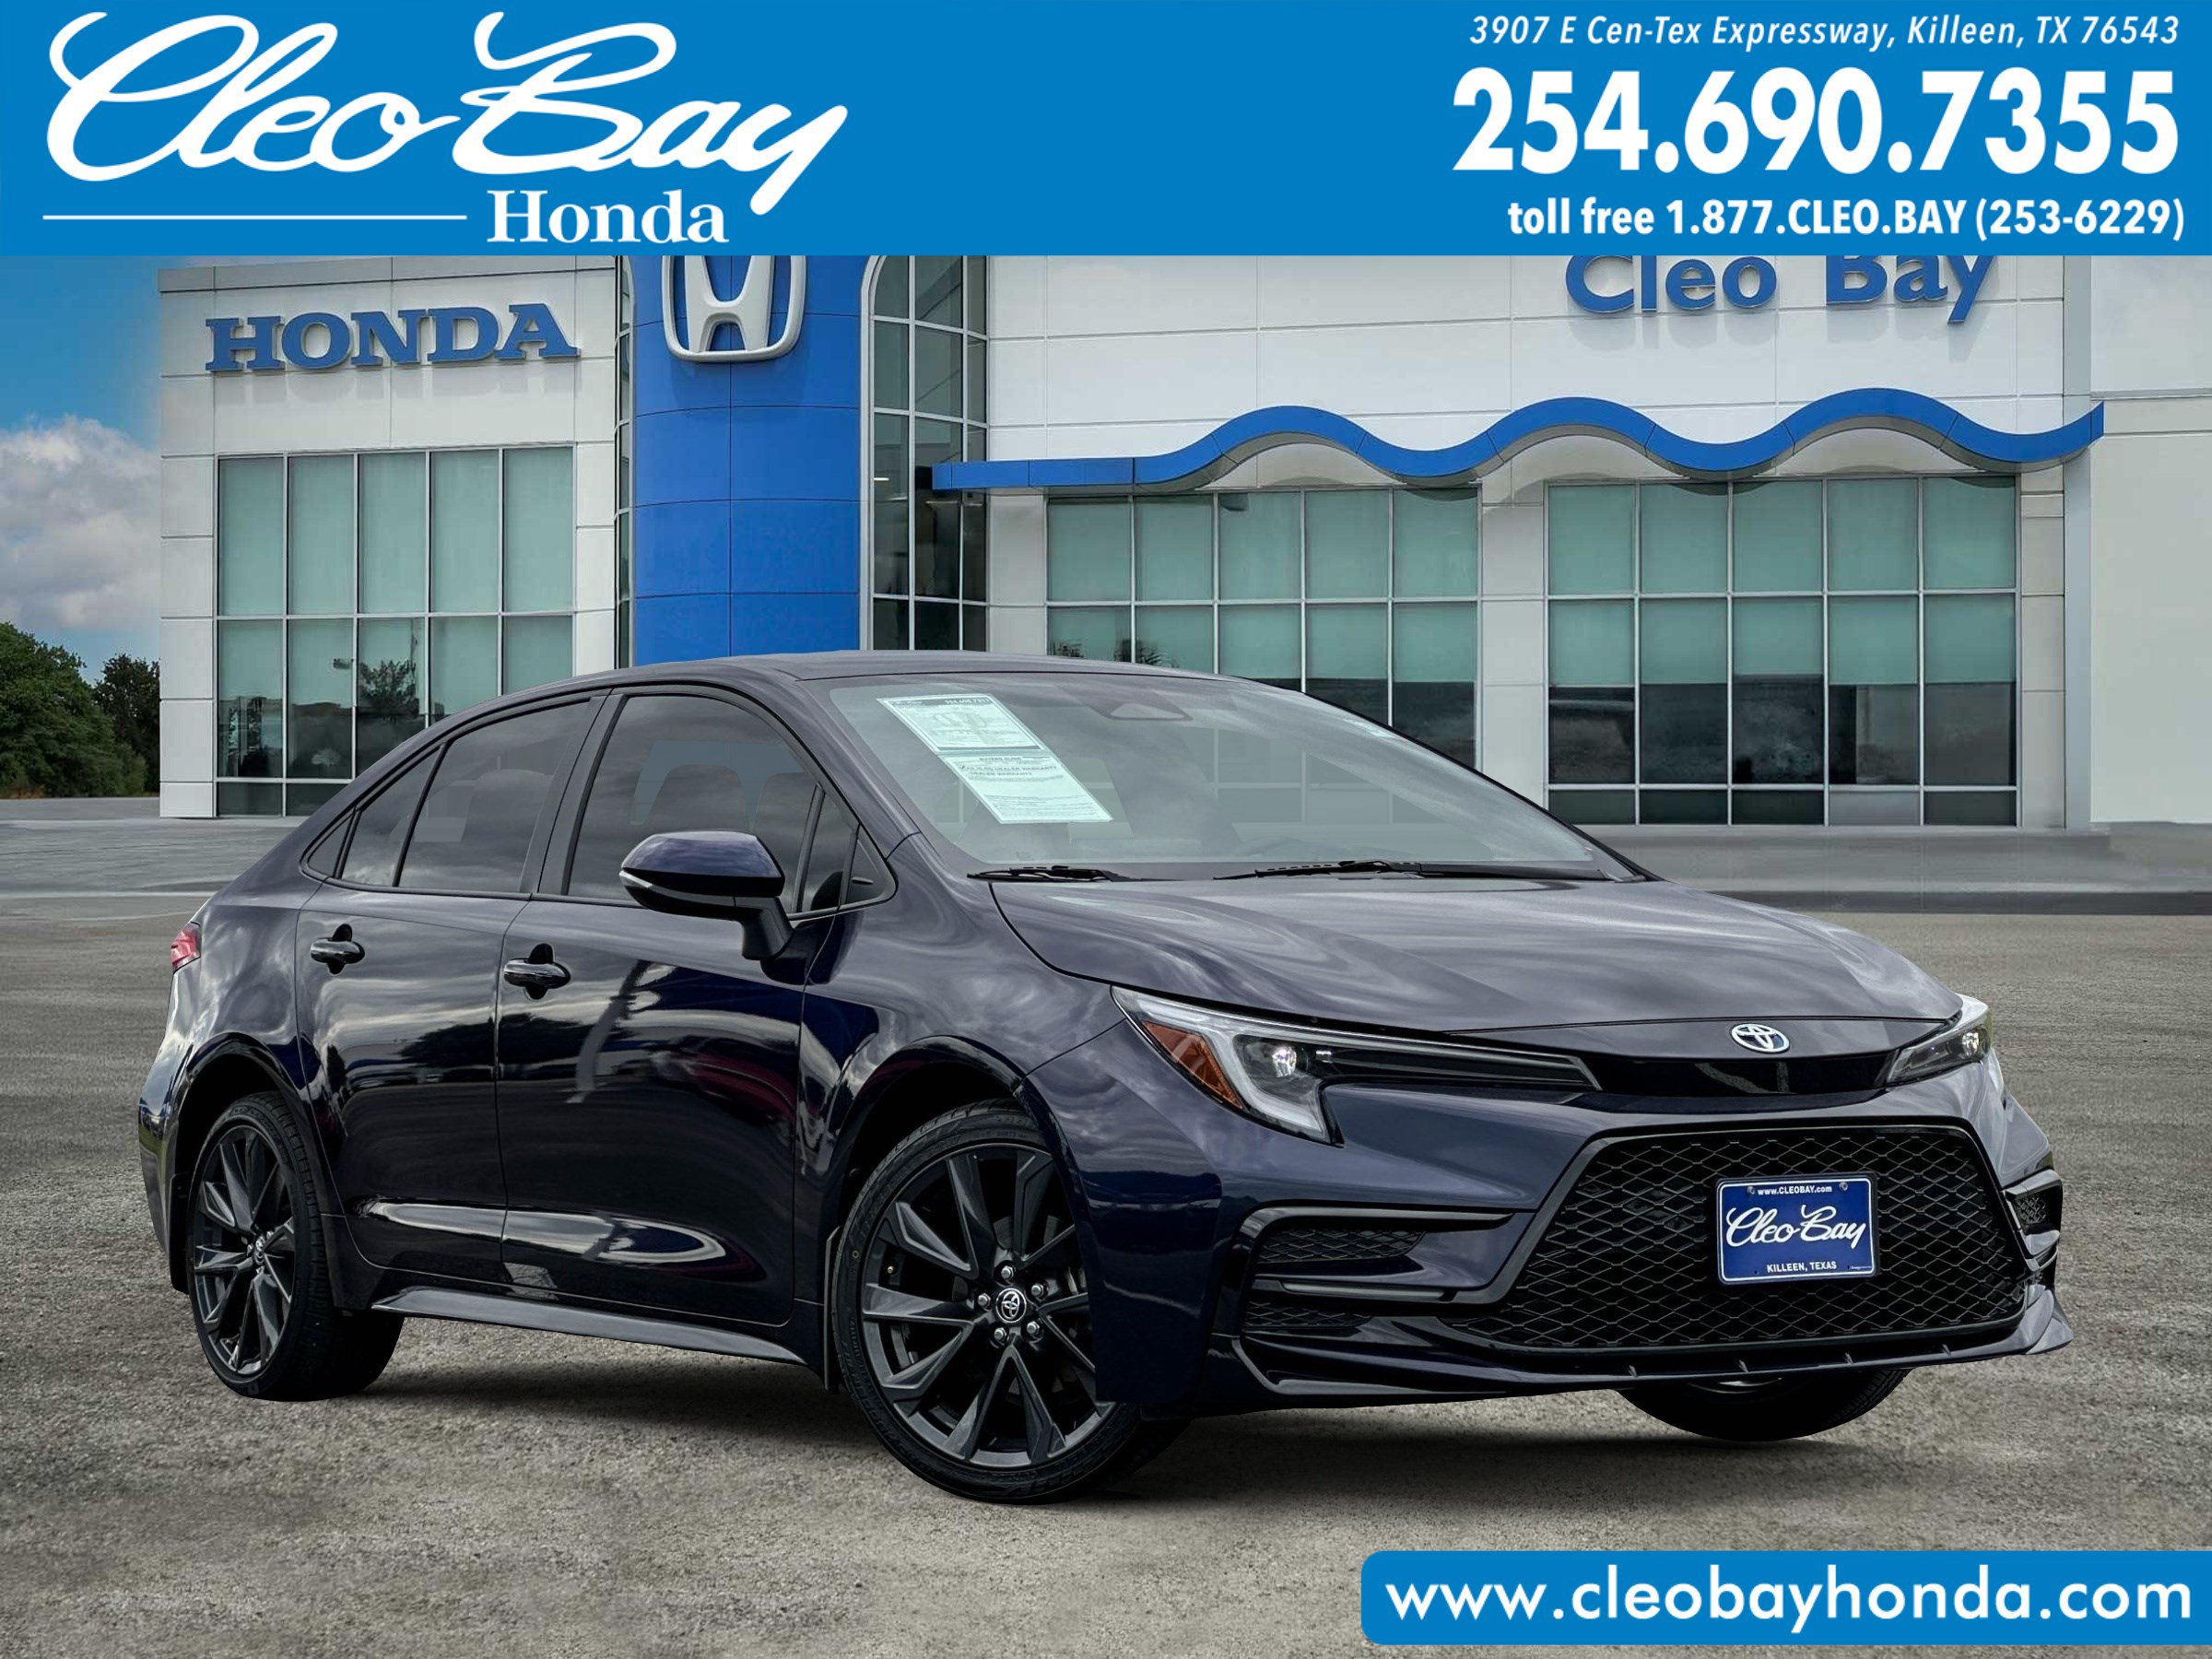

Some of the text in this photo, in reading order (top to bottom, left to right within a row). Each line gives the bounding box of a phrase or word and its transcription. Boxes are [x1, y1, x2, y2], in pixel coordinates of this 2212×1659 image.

[1565, 255, 1994, 324] Cleo Bay
[205, 302, 582, 373] HONDA
[1758, 1185, 1832, 1195] www.CLEOBAY.com
[1725, 1205, 1866, 1250] Cleo Bay
[1767, 1261, 1837, 1273] KILLEEN, TEXAS
